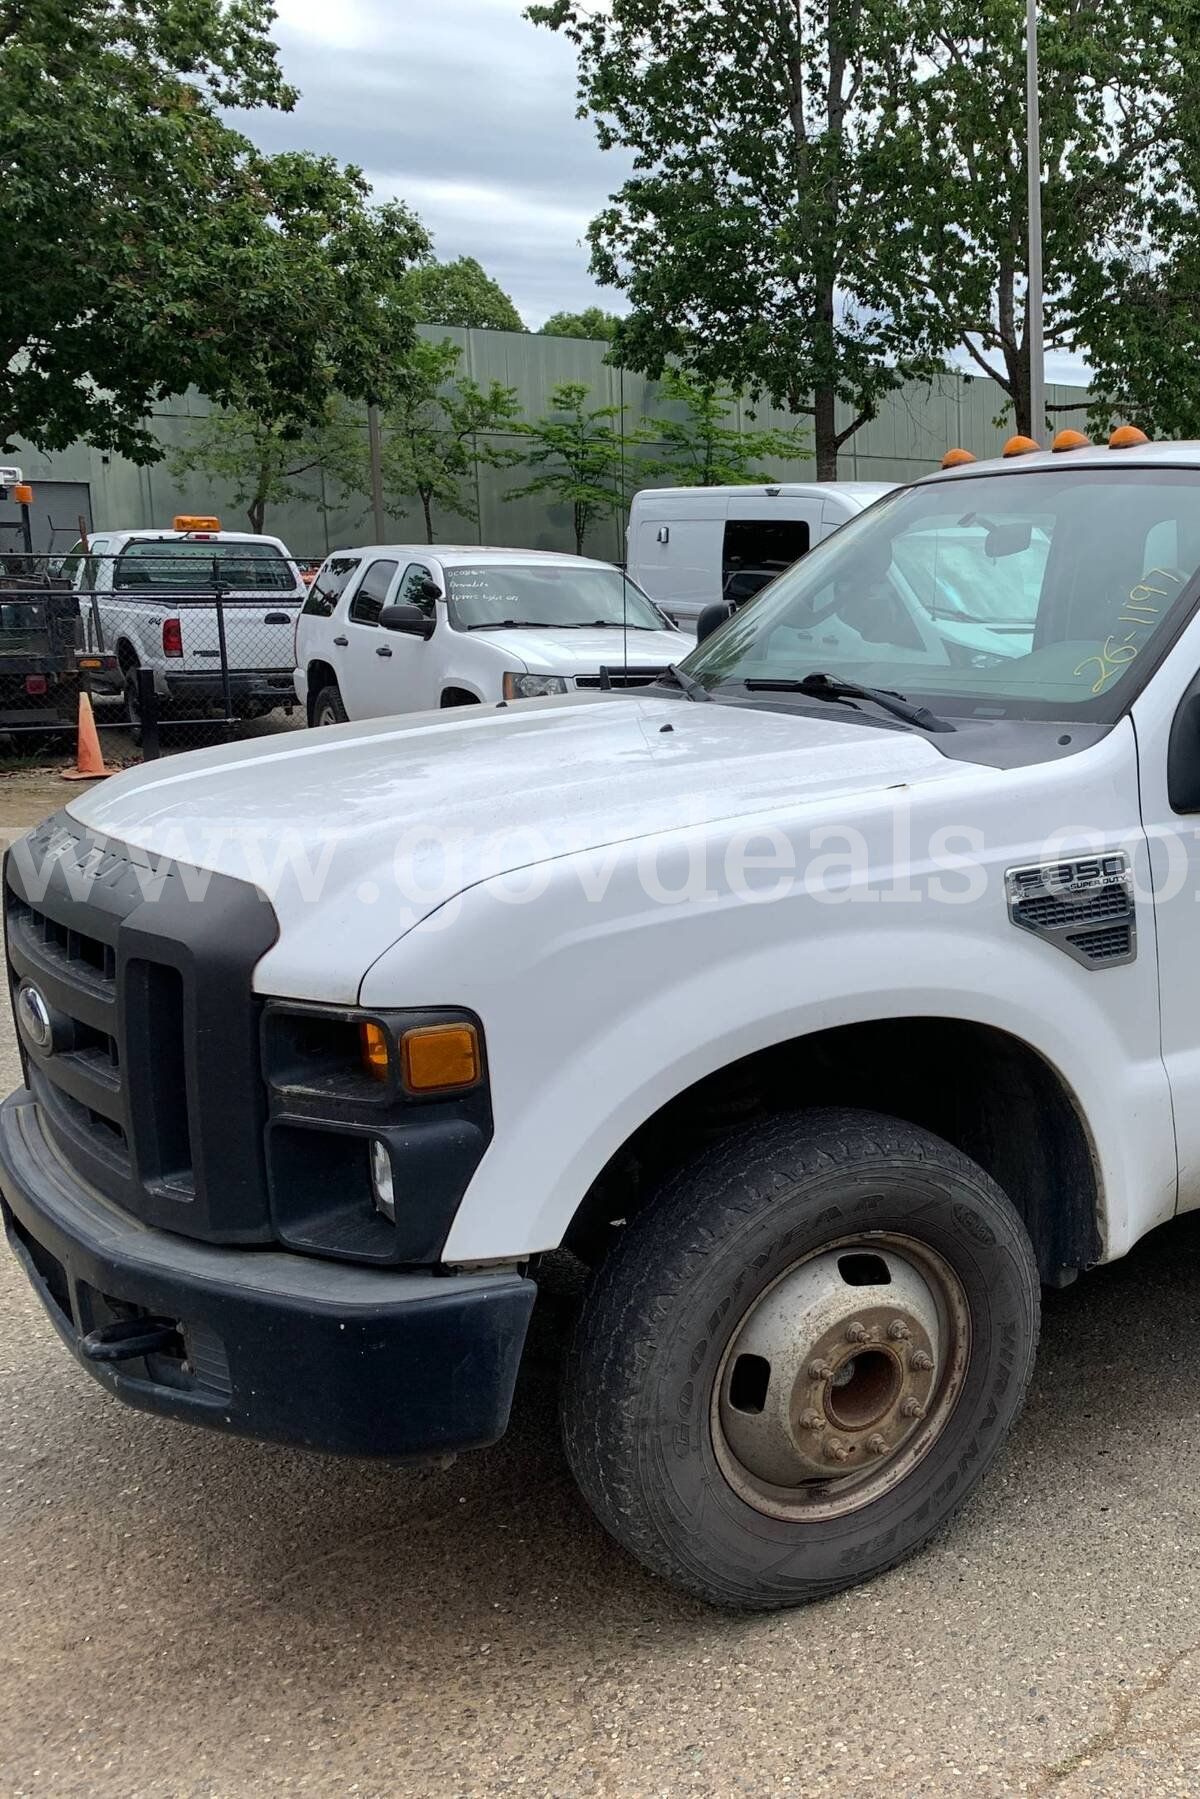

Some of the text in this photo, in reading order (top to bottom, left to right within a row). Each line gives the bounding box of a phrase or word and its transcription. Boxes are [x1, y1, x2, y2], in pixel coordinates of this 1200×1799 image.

[1073, 568, 1180, 693] 26-1197
[1069, 875, 1127, 891] SUPER DUTY
